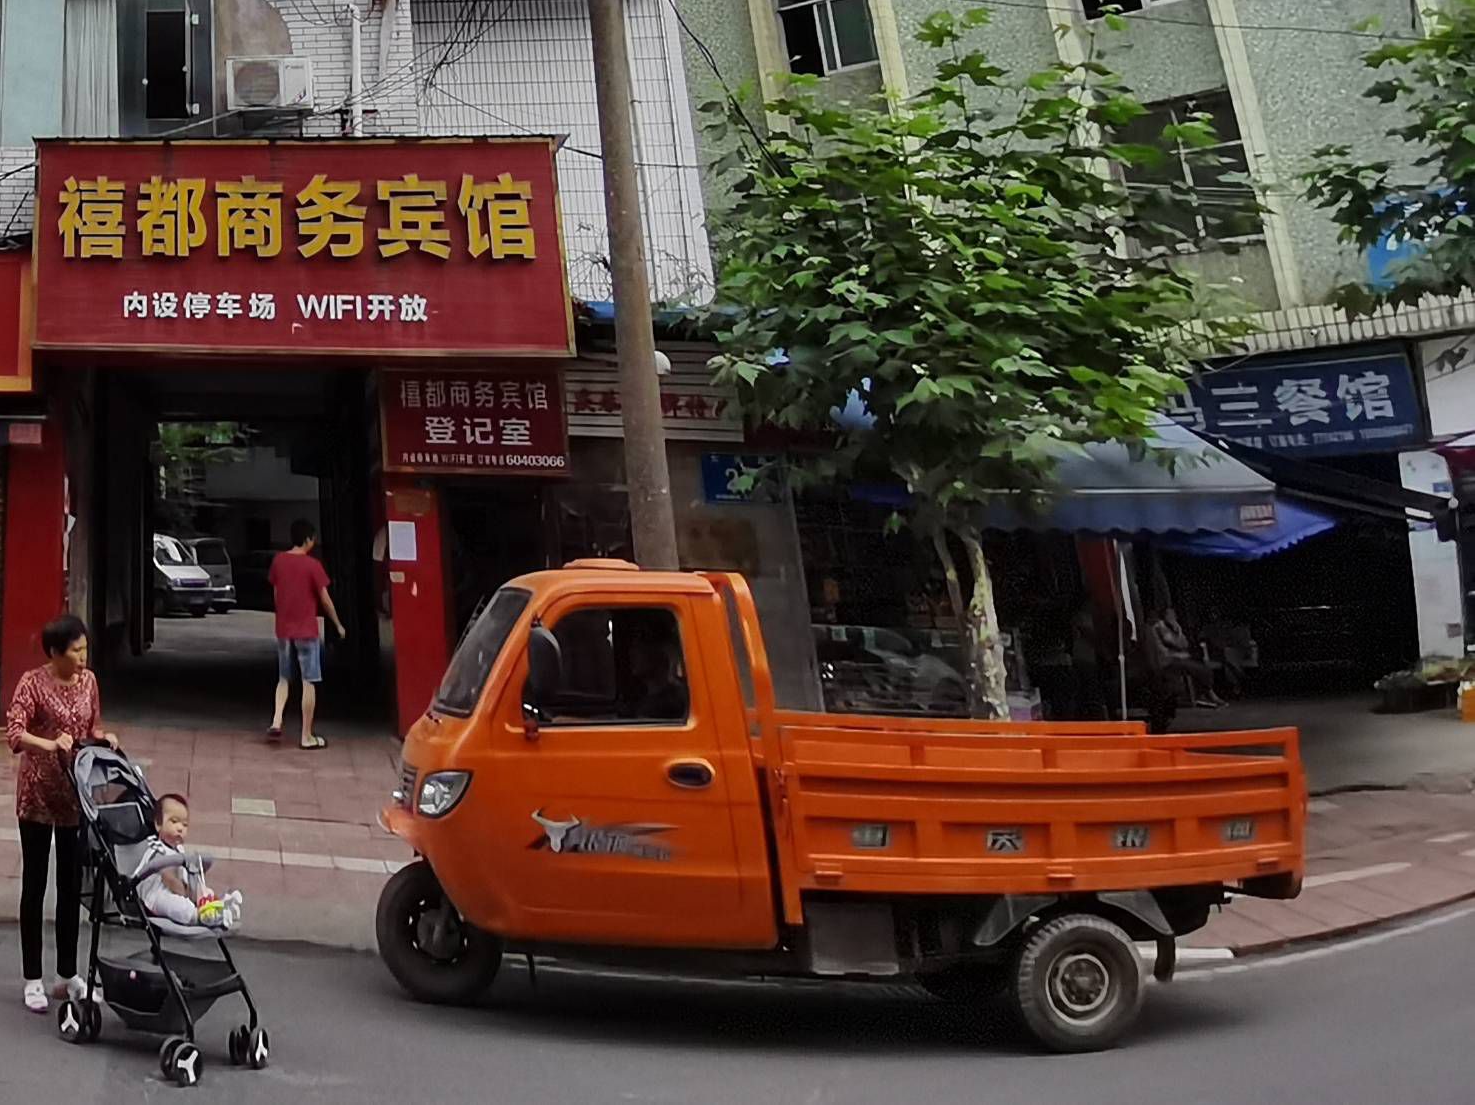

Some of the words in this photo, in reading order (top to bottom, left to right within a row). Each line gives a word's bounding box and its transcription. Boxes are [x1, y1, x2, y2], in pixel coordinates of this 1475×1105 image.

[59, 173, 538, 261] 禧都商务宾馆
[123, 291, 276, 321] 内设停车场
[297, 294, 428, 322] WIFI开放
[425, 416, 532, 446] 登记室
